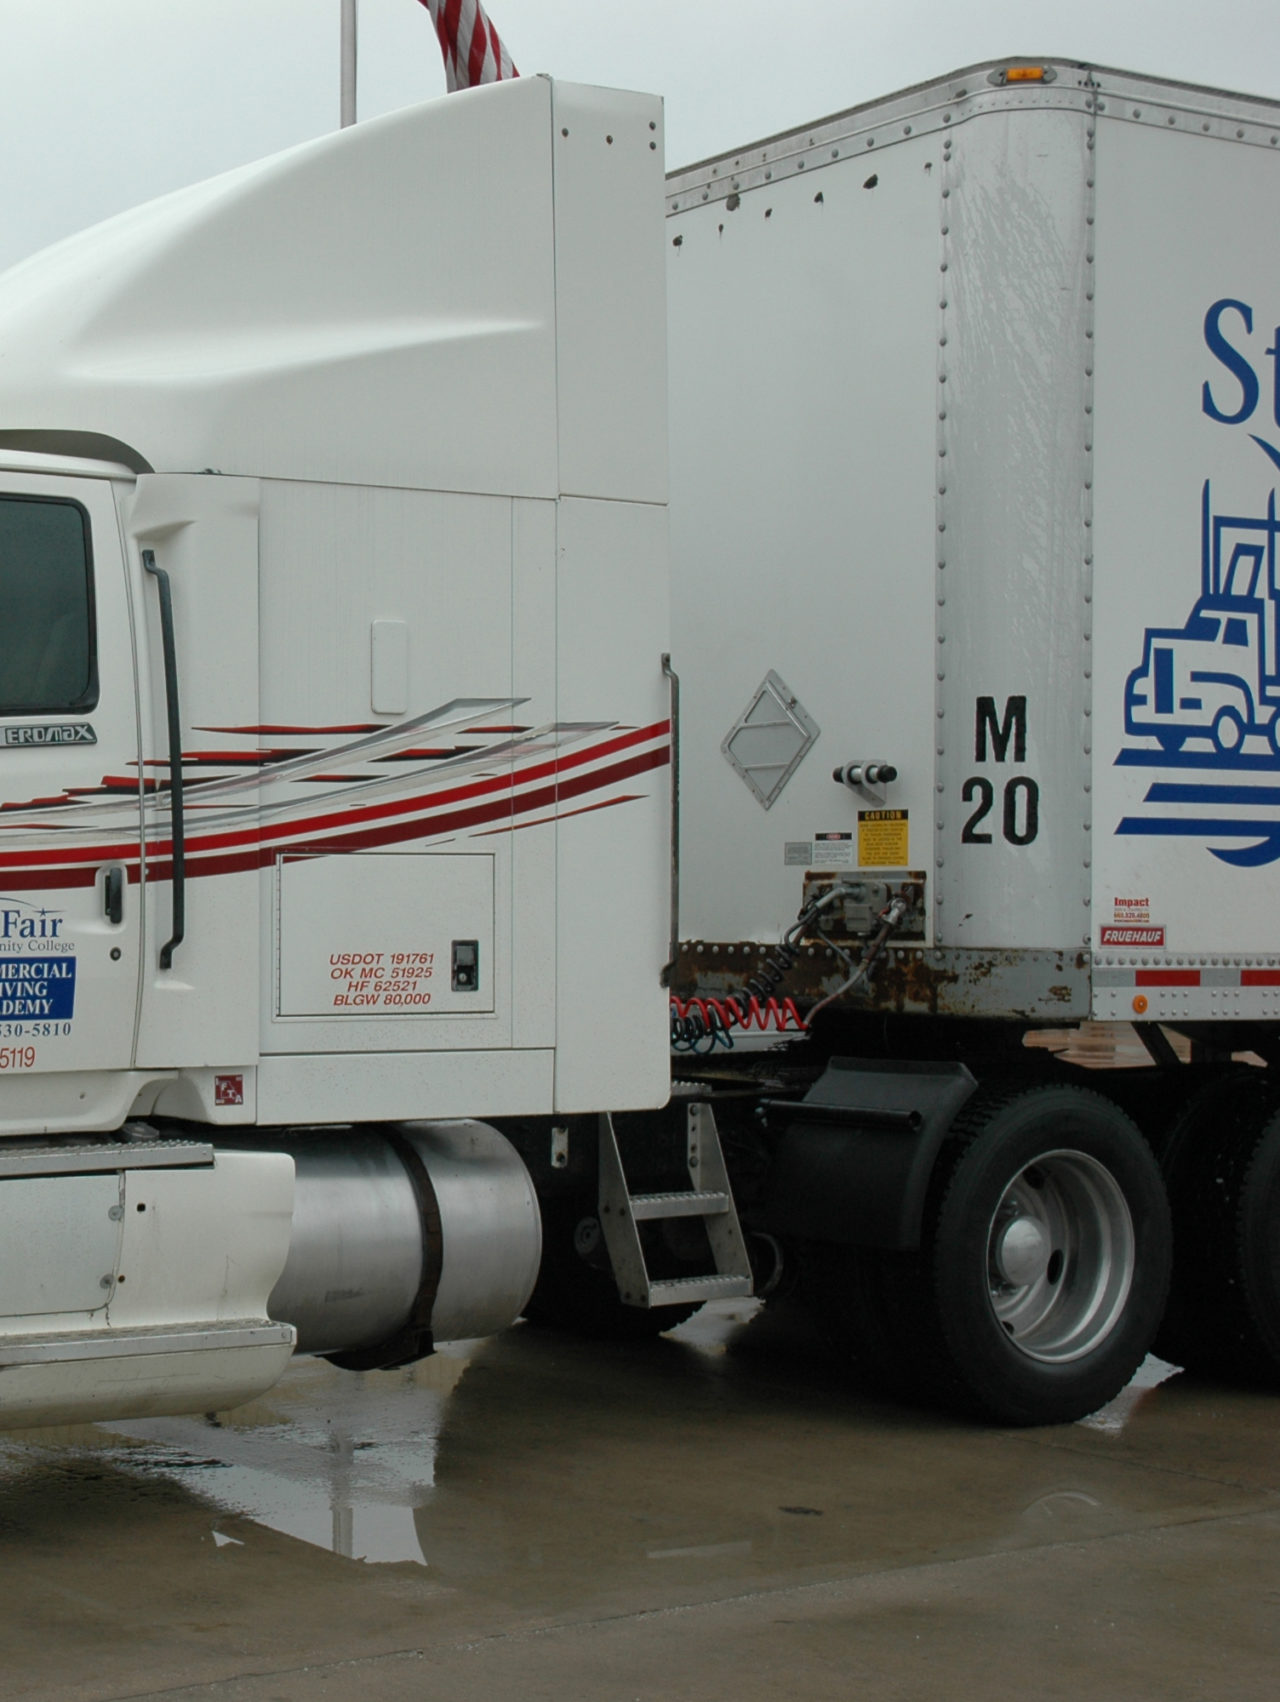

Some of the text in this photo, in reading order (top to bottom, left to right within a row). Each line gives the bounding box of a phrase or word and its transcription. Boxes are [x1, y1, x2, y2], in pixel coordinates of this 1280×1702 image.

[975, 696, 1026, 763] M
[864, 810, 902, 820] CAUTION
[961, 776, 1039, 846] 20
[1114, 897, 1150, 908] Impact
[1, 909, 63, 938] Fair
[1103, 930, 1161, 943] FRUEHAUF
[28, 940, 75, 953] College
[329, 953, 434, 965] USDOT 191761
[330, 967, 432, 979] OK MC 51925
[347, 981, 417, 992] HF 62521
[333, 993, 431, 1006] BLGW 80,000
